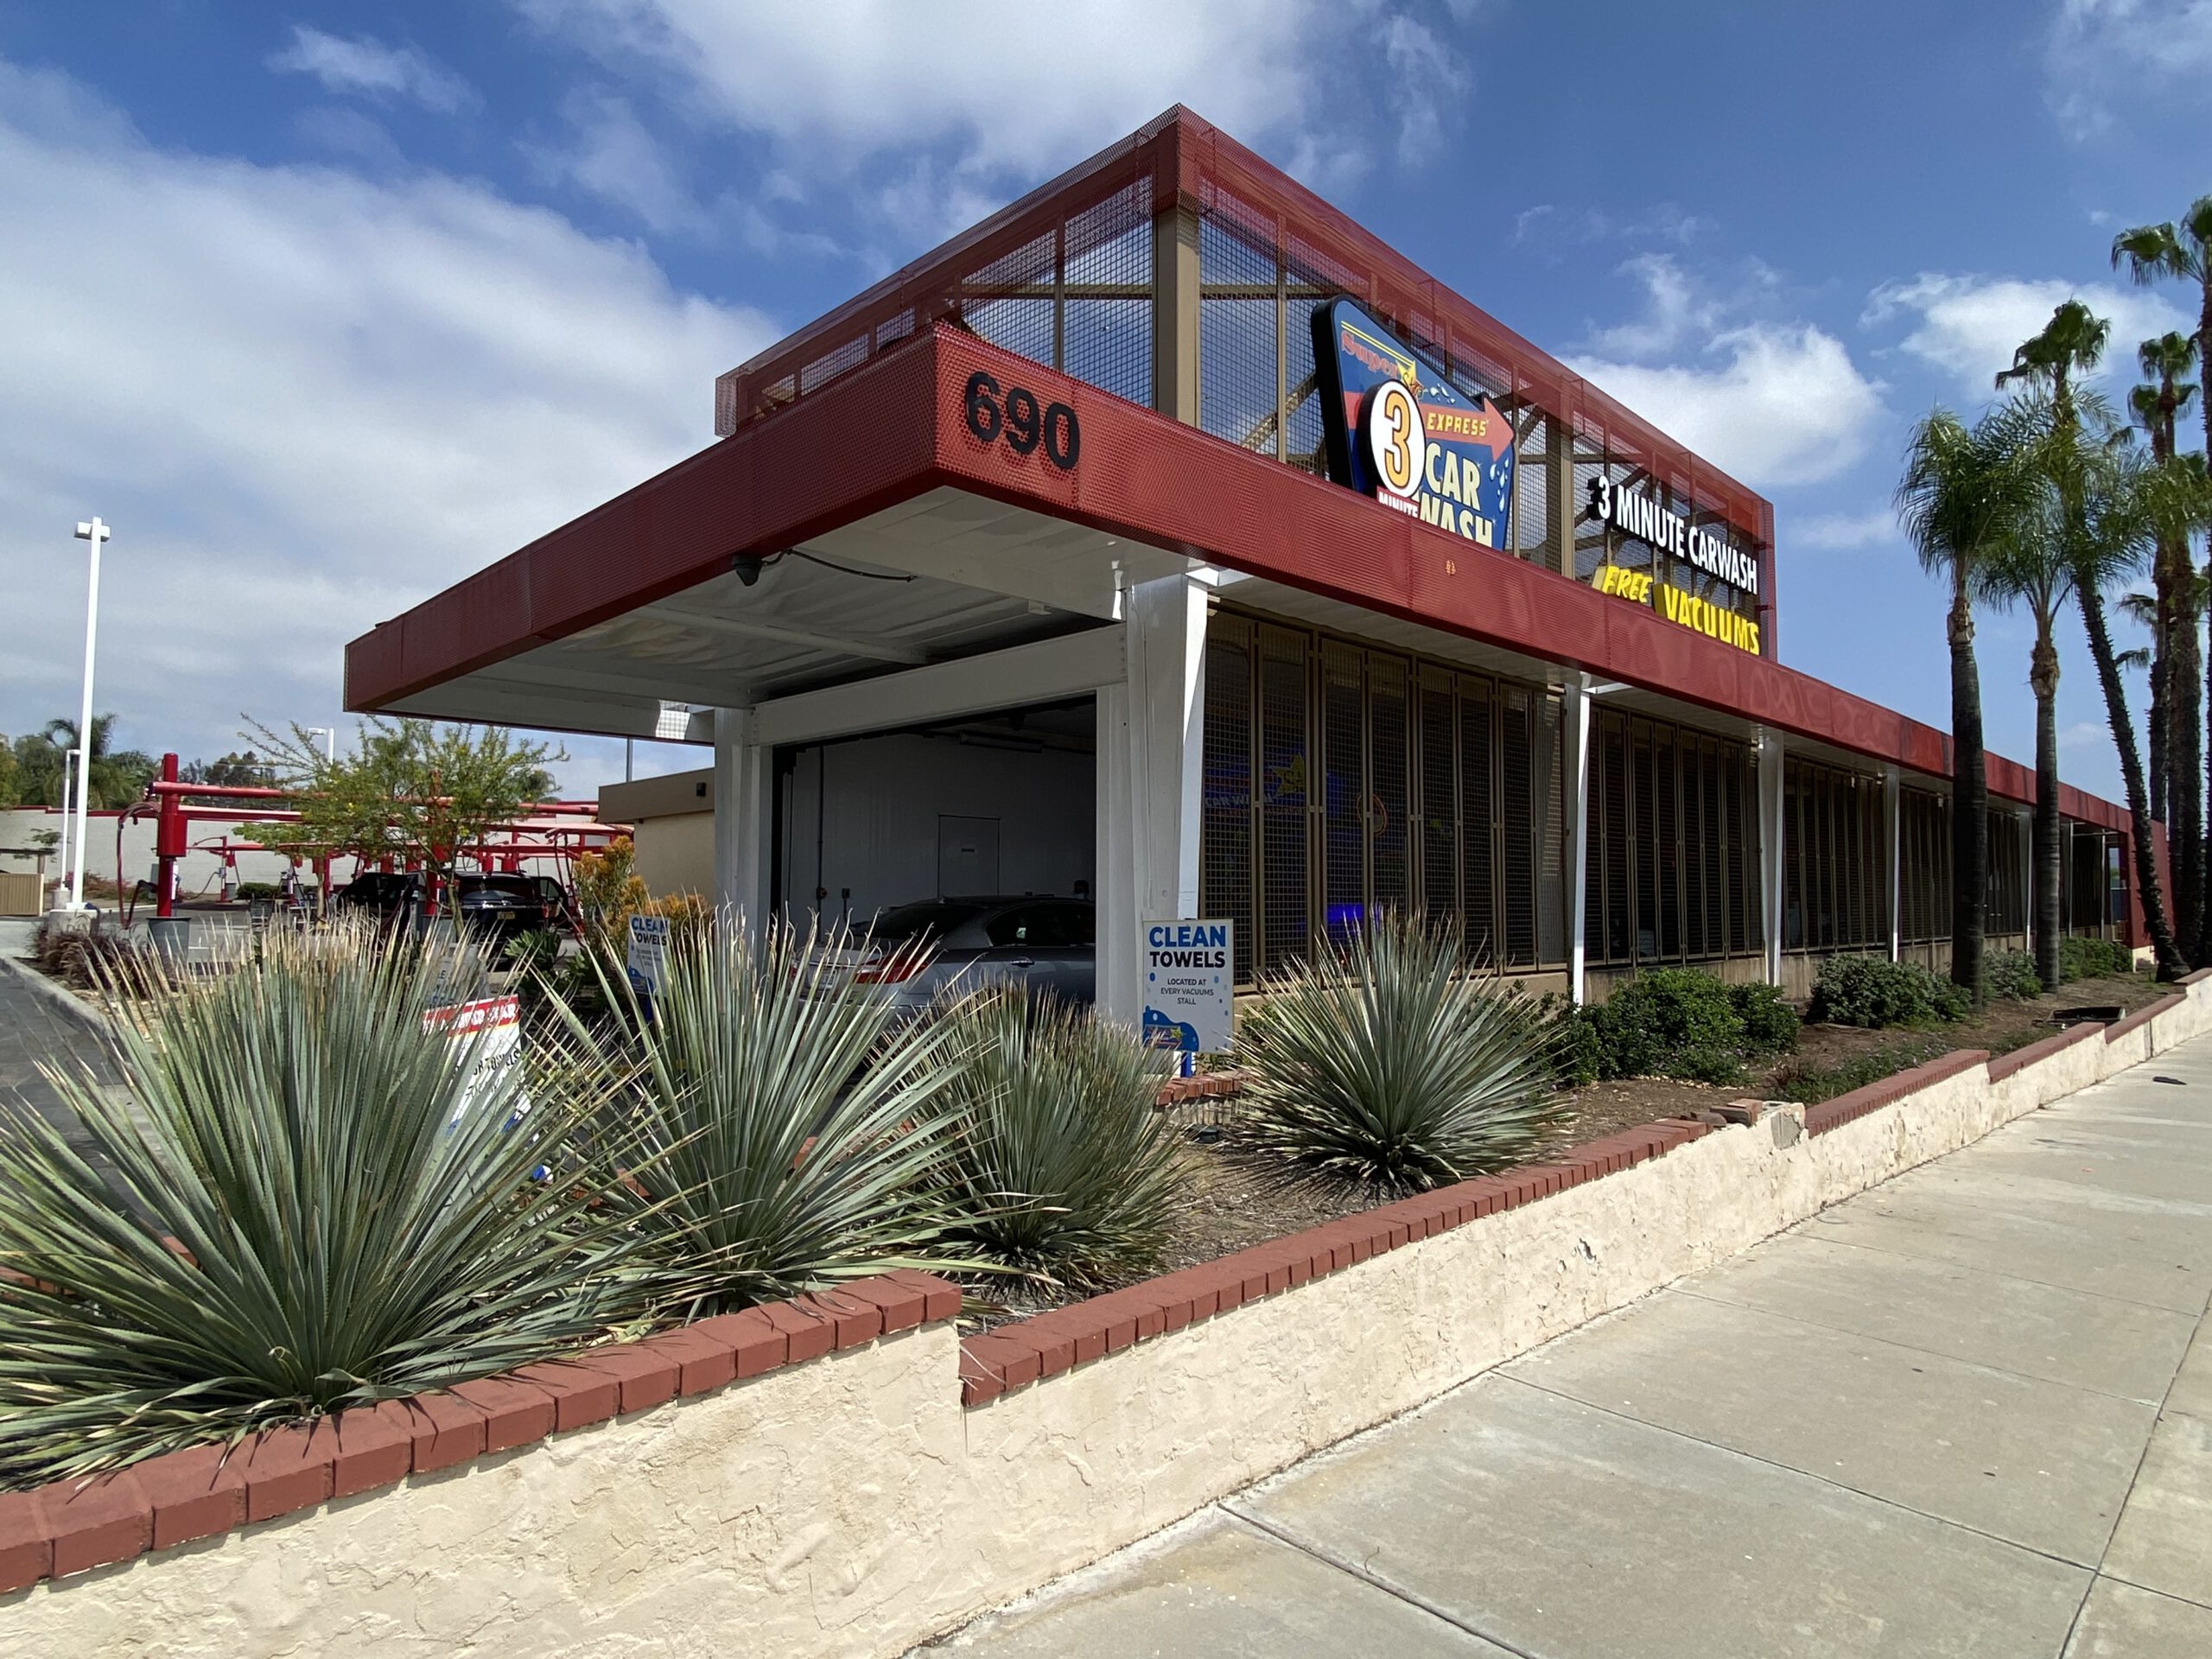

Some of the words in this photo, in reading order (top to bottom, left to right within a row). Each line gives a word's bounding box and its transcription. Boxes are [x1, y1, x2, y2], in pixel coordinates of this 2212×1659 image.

[966, 371, 1080, 470] 690
[1384, 389, 1412, 490] 3
[1427, 413, 1487, 437] EXPRESS
[1426, 442, 1482, 512] CAR
[1411, 491, 1493, 547] WASH
[1599, 475, 1611, 519] 3
[1616, 484, 1685, 559] MINUTE
[1688, 525, 1758, 594] CARWASH
[1601, 565, 1653, 603] FREE
[1663, 584, 1760, 657] VACUUMS
[632, 931, 667, 946] OWELS
[1149, 925, 1226, 948] CLEAN
[1149, 951, 1226, 969] TOWELS
